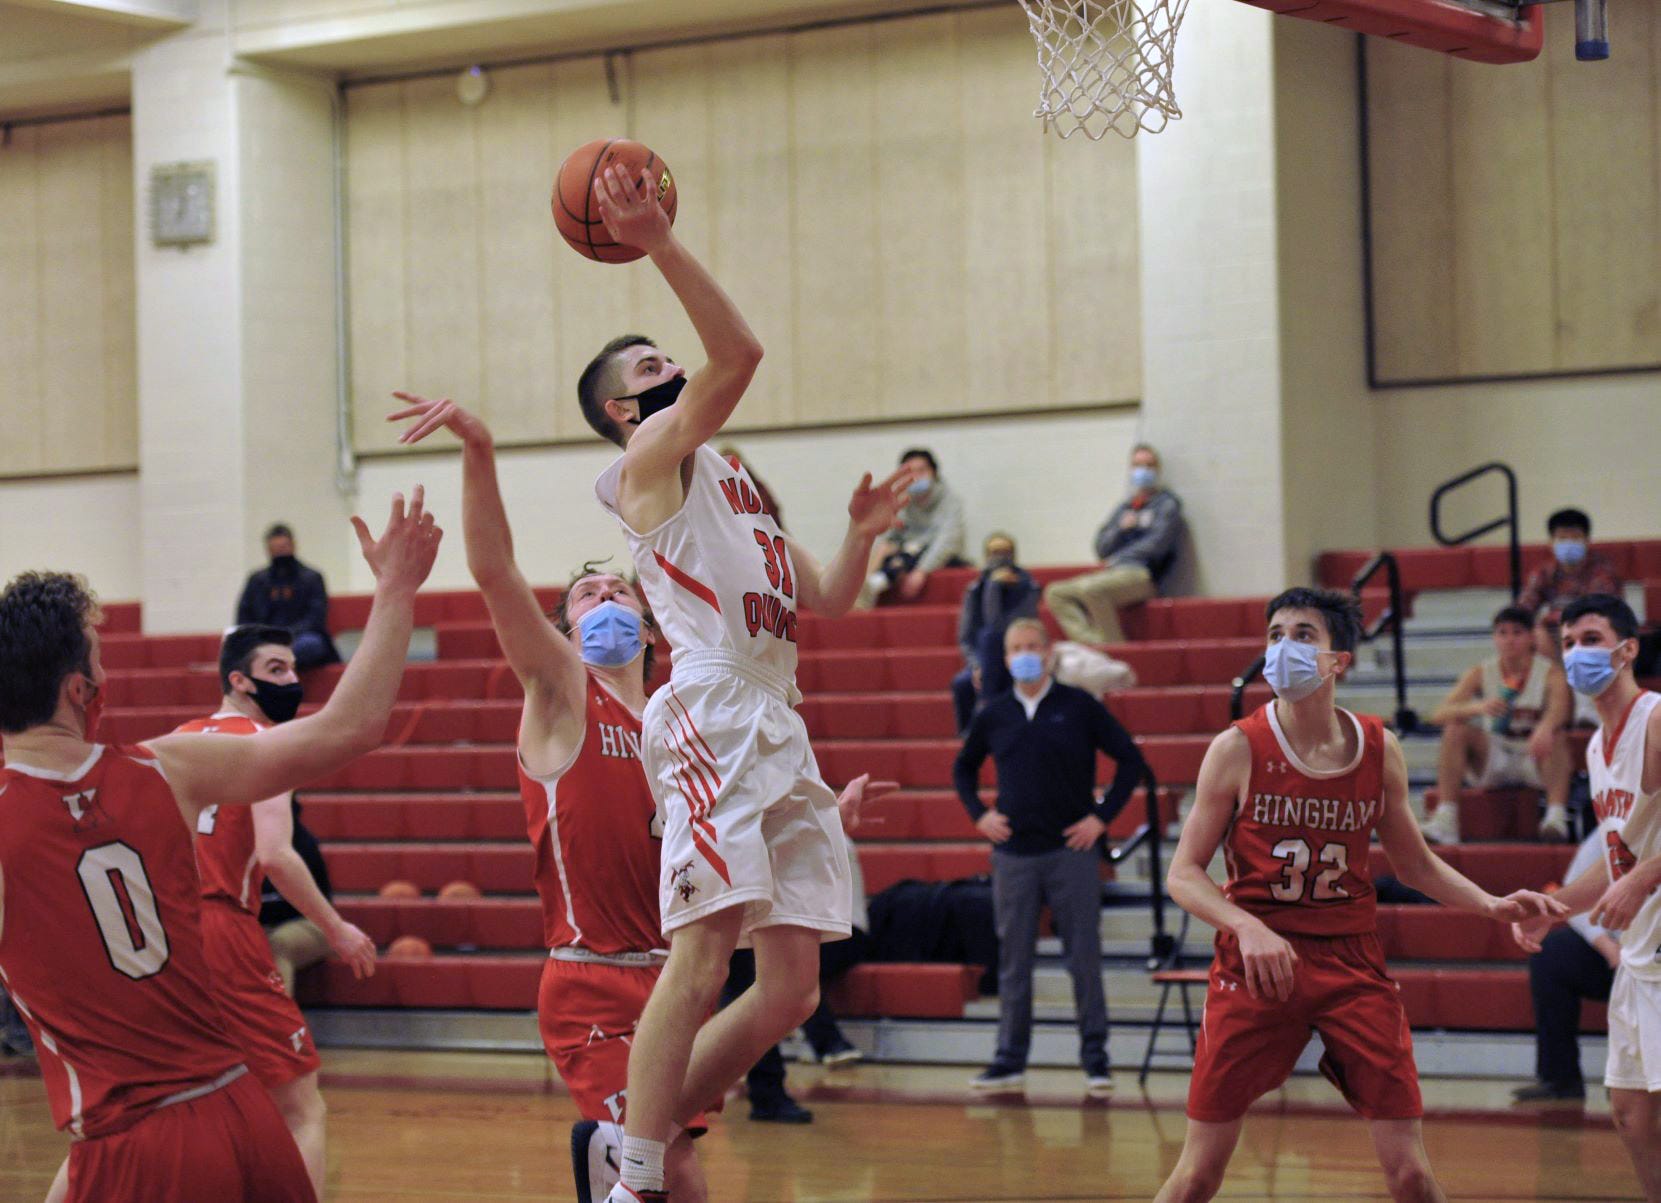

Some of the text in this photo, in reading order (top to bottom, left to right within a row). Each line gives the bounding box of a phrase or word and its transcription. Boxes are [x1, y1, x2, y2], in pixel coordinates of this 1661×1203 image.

[719, 477, 769, 515] NO
[754, 528, 793, 598] 31
[598, 722, 642, 760] HIN
[1253, 793, 1377, 831] HINGHAM
[1269, 838, 1349, 902] 32
[77, 839, 169, 981] 0
